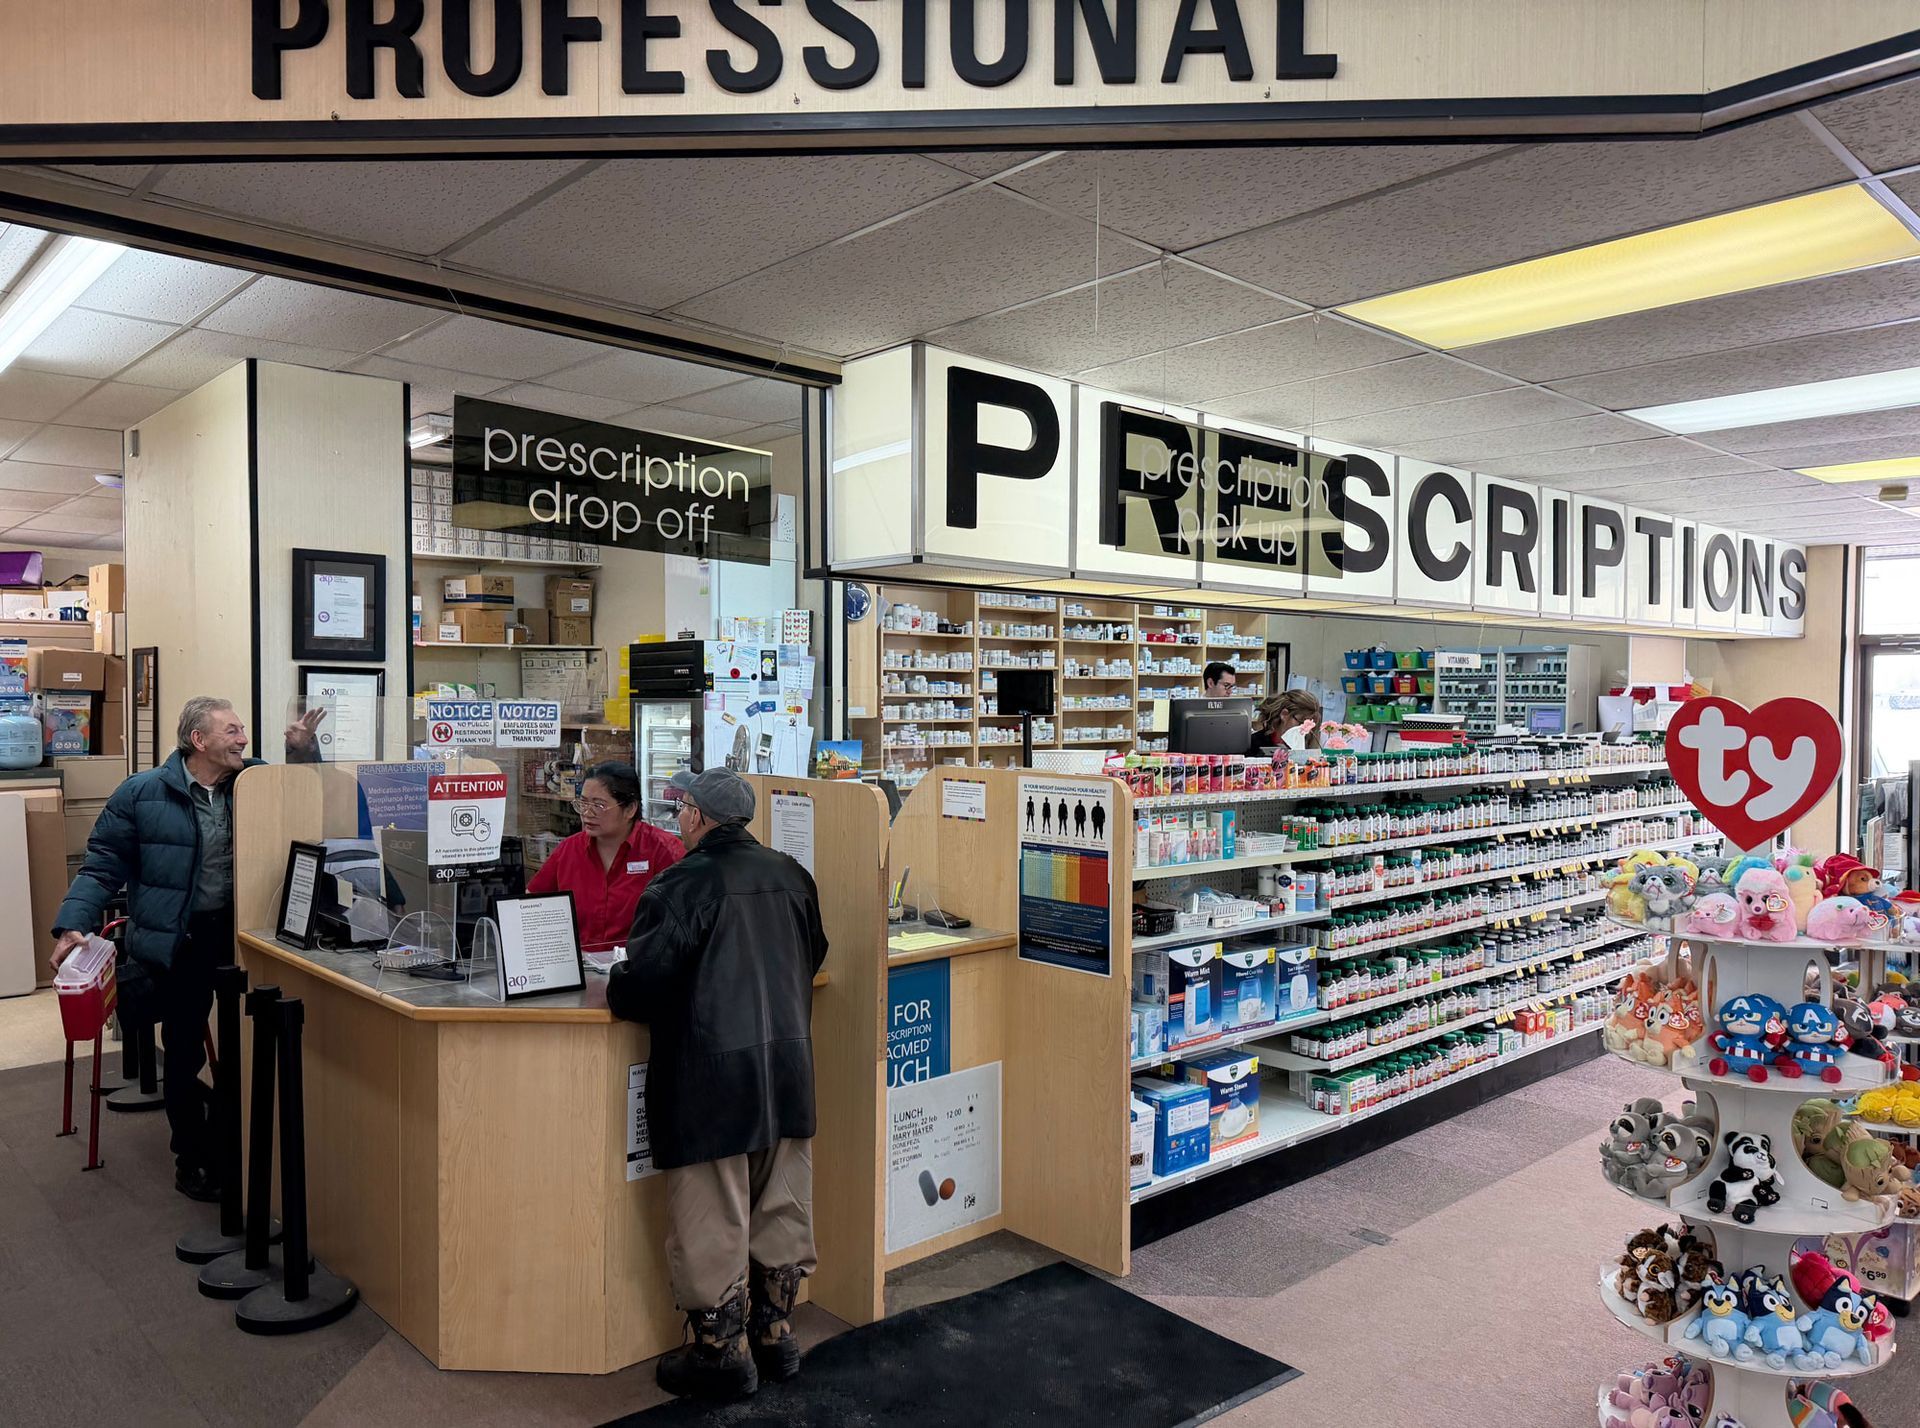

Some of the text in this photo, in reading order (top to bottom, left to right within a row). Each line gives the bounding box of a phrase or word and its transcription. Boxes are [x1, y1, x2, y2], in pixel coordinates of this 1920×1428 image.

[250, 0, 1337, 101] PROFESSIONAL
[484, 427, 749, 502] prescription
[1140, 444, 1329, 511] prescription
[946, 364, 1808, 620] PRESCRIPTIONS
[529, 482, 715, 544] drop off
[1178, 501, 1297, 565] pick up
[1447, 656, 1470, 665] VITAMINS
[430, 704, 492, 719] NOTICE
[501, 705, 555, 719] NOTICE
[358, 762, 445, 774] PHARMACY SERVICES
[1679, 706, 1817, 822] ty
[434, 780, 504, 793] ATTENTION
[397, 803, 422, 811] Services
[1184, 967, 1210, 978] Warm Mist
[894, 999, 932, 1026] FOR
[886, 1023, 932, 1042] ESCRIPTION
[1220, 1086, 1234, 1095] Warm
[1234, 1082, 1248, 1090] Steam
[894, 1107, 923, 1124] LUNCH
[920, 1117, 928, 1126] 22
[946, 1108, 962, 1119] 12:00
[892, 1124, 934, 1142] MARY MAYER
